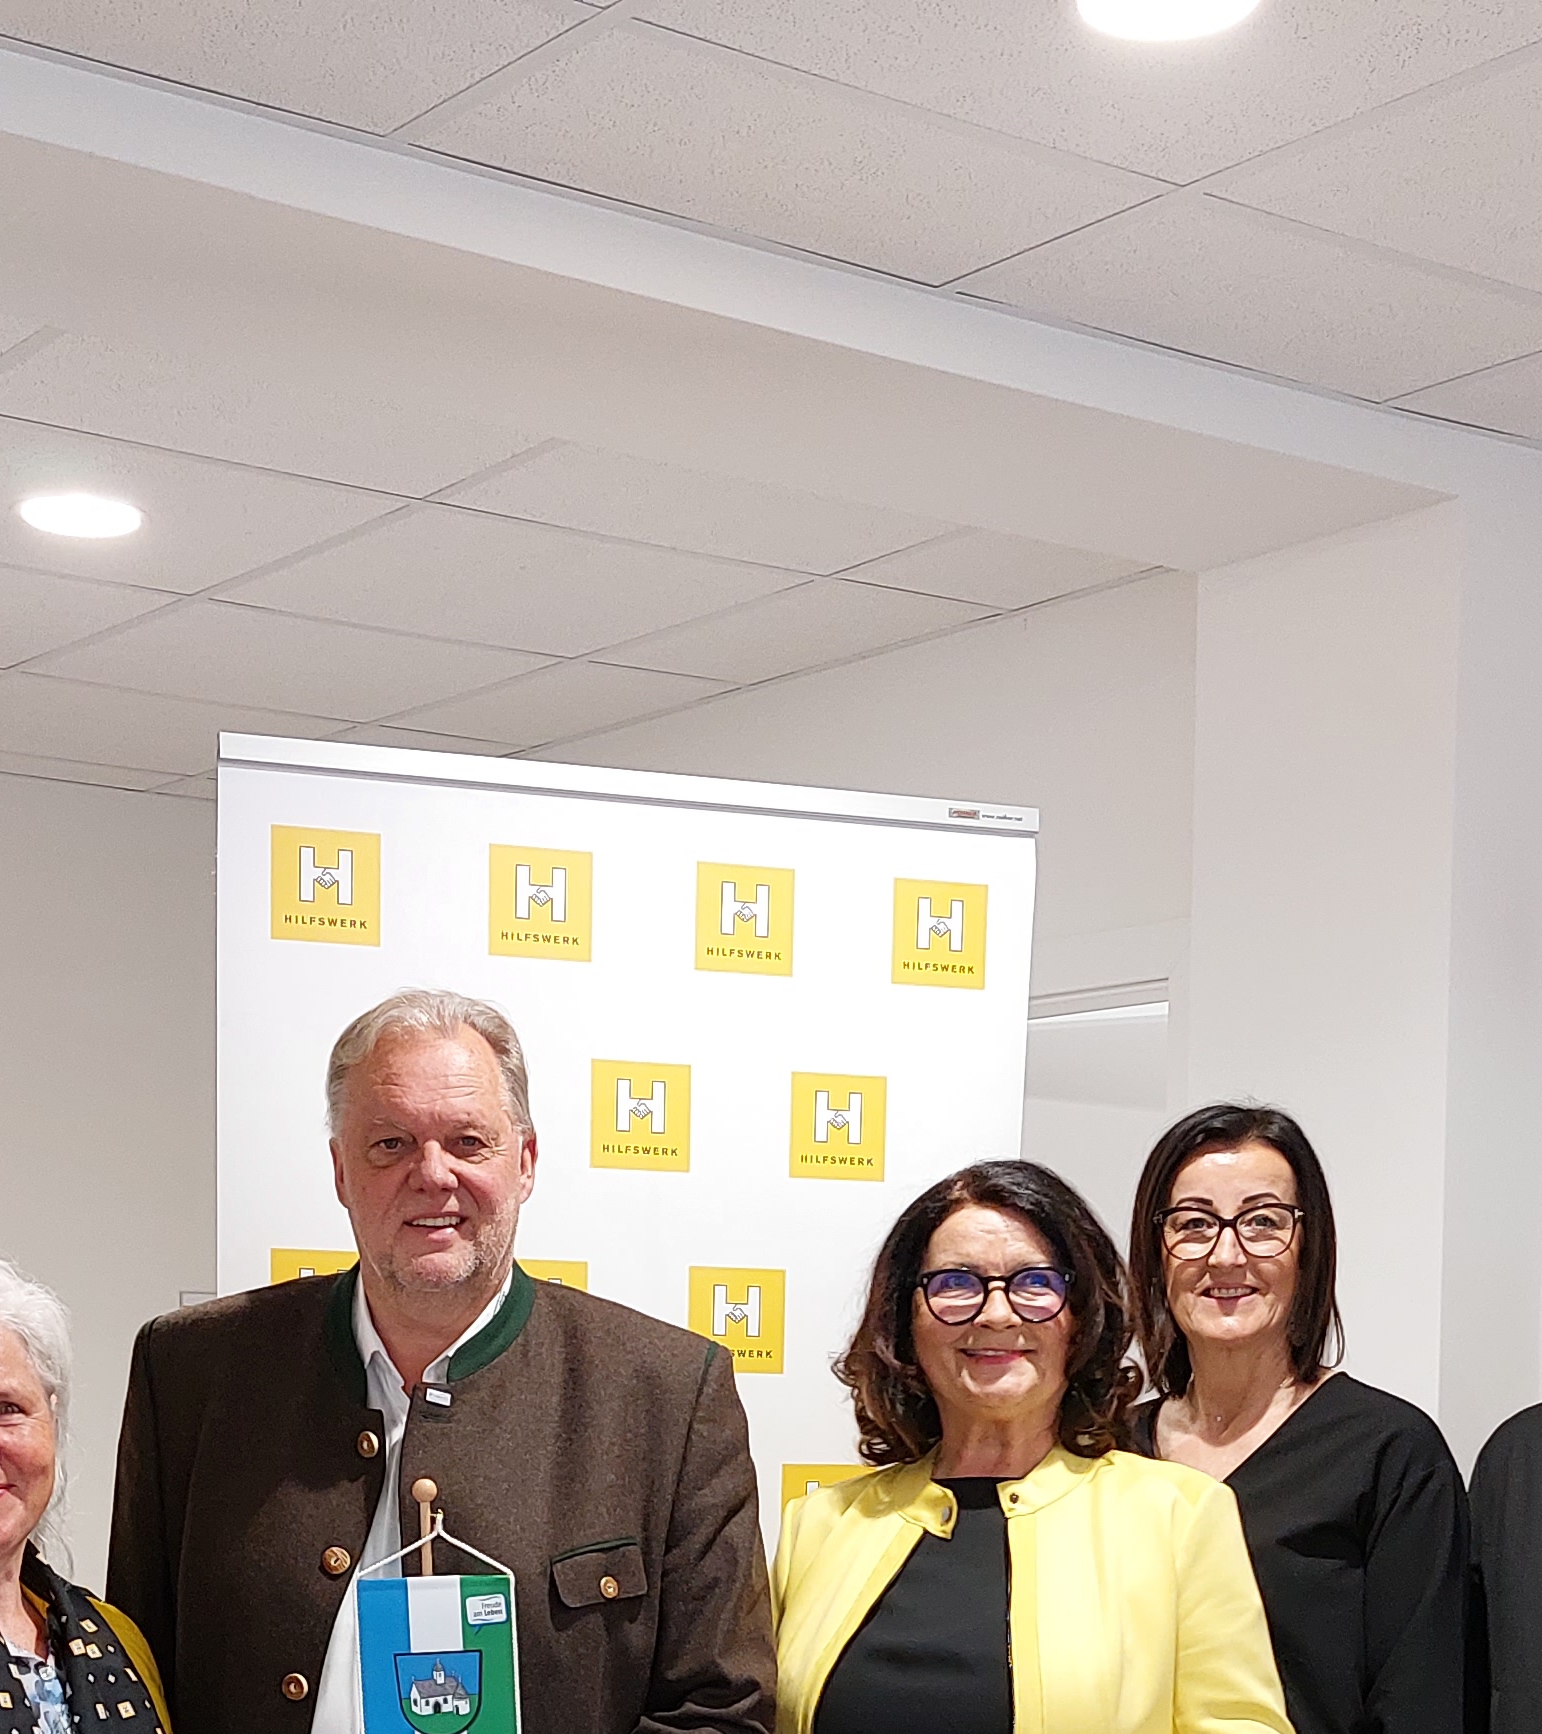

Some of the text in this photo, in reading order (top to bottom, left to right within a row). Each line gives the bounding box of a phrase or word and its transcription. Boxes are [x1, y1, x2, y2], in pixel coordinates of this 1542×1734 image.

[284, 913, 369, 930] HILFSWERK
[500, 929, 581, 948] HILFSWERK
[705, 945, 782, 962] HILFSWERK
[901, 960, 976, 976] HILFSWERK
[601, 1142, 680, 1159] HILFSWERK
[799, 1153, 875, 1168] HILFSWERK
[729, 1349, 773, 1359] SWERK
